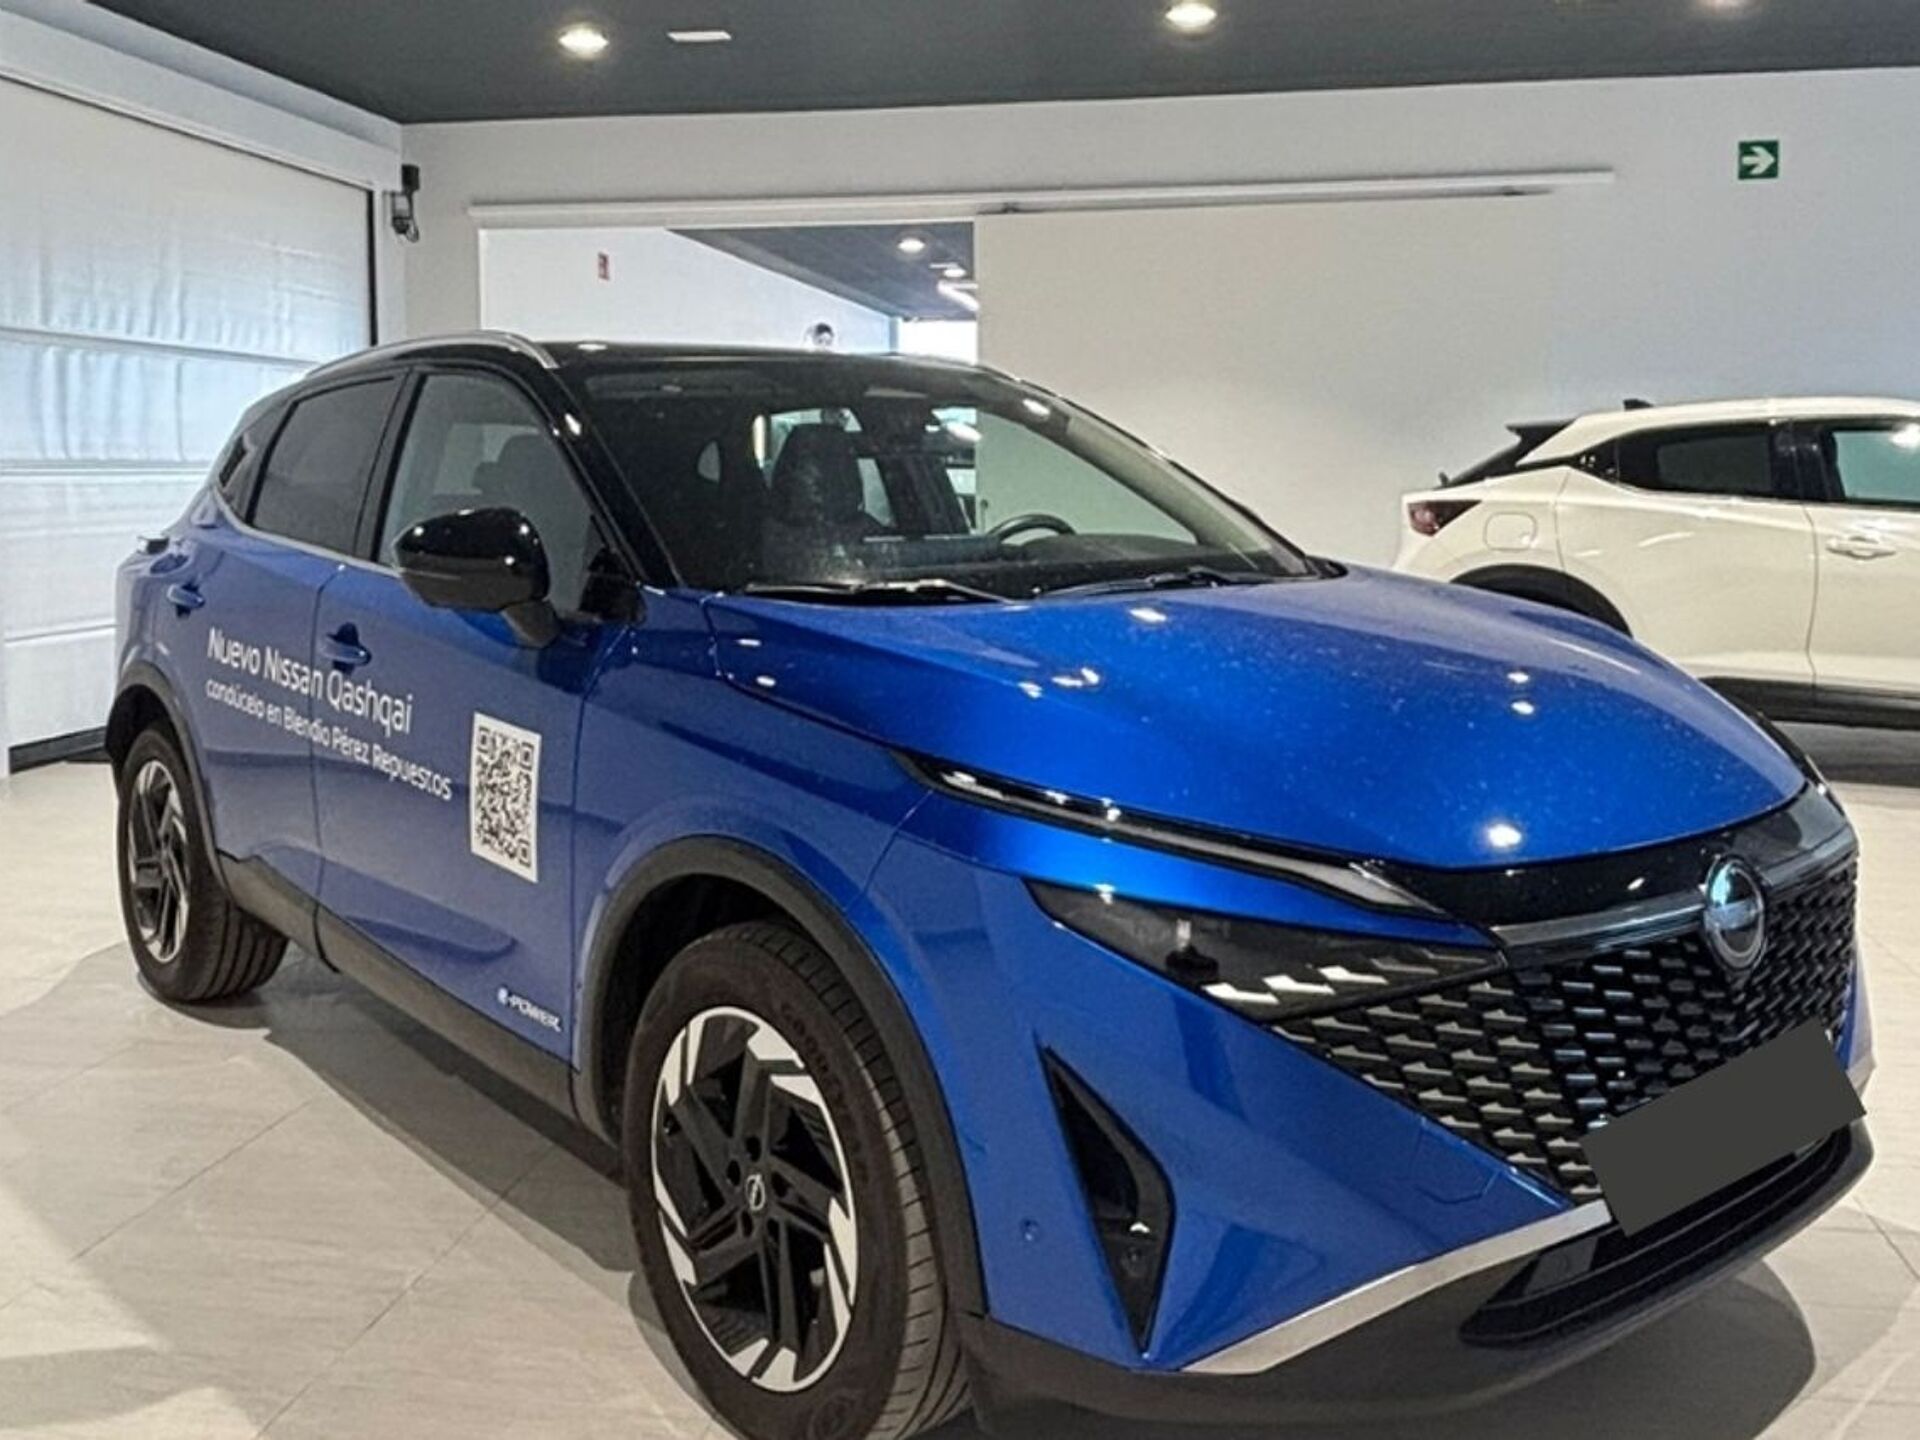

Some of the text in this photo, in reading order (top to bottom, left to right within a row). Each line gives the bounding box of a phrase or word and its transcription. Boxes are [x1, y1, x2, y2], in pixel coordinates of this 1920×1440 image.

[207, 627, 413, 737] Nuevo Nissan Qashqai
[266, 703, 282, 725] en
[332, 726, 369, 764] Pérez
[372, 743, 452, 801] Repuestos
